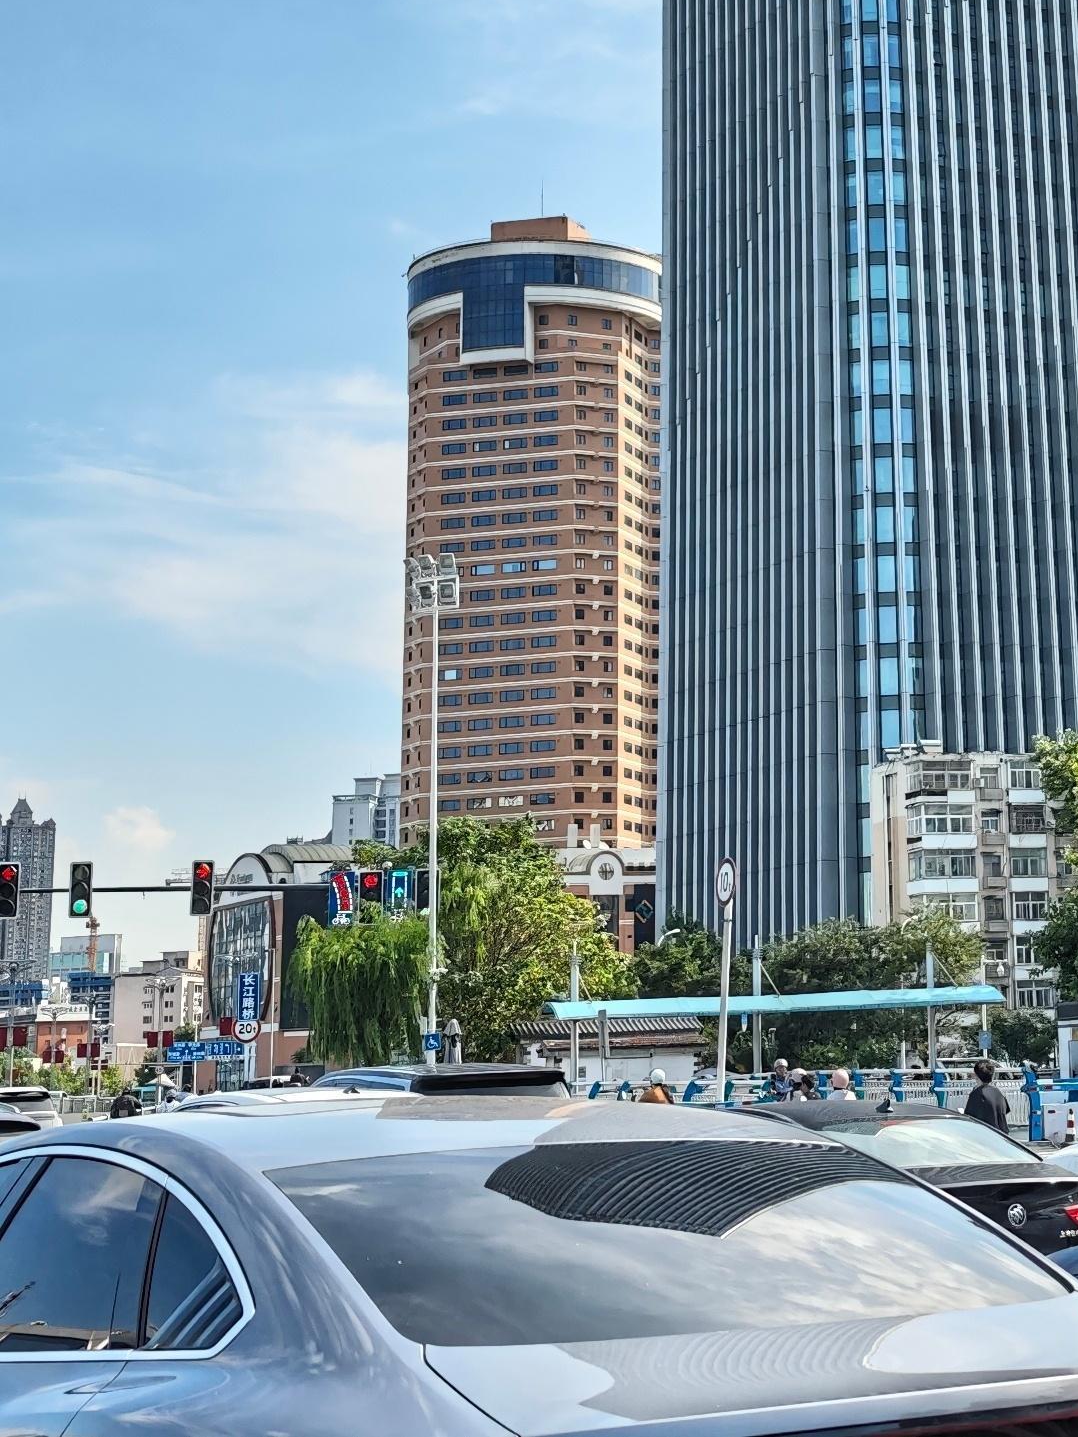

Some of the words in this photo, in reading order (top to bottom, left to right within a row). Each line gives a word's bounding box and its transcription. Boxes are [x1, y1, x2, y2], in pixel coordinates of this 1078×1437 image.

[241, 974, 256, 1020] 长江路桥
[238, 1023, 256, 1034] 20t
